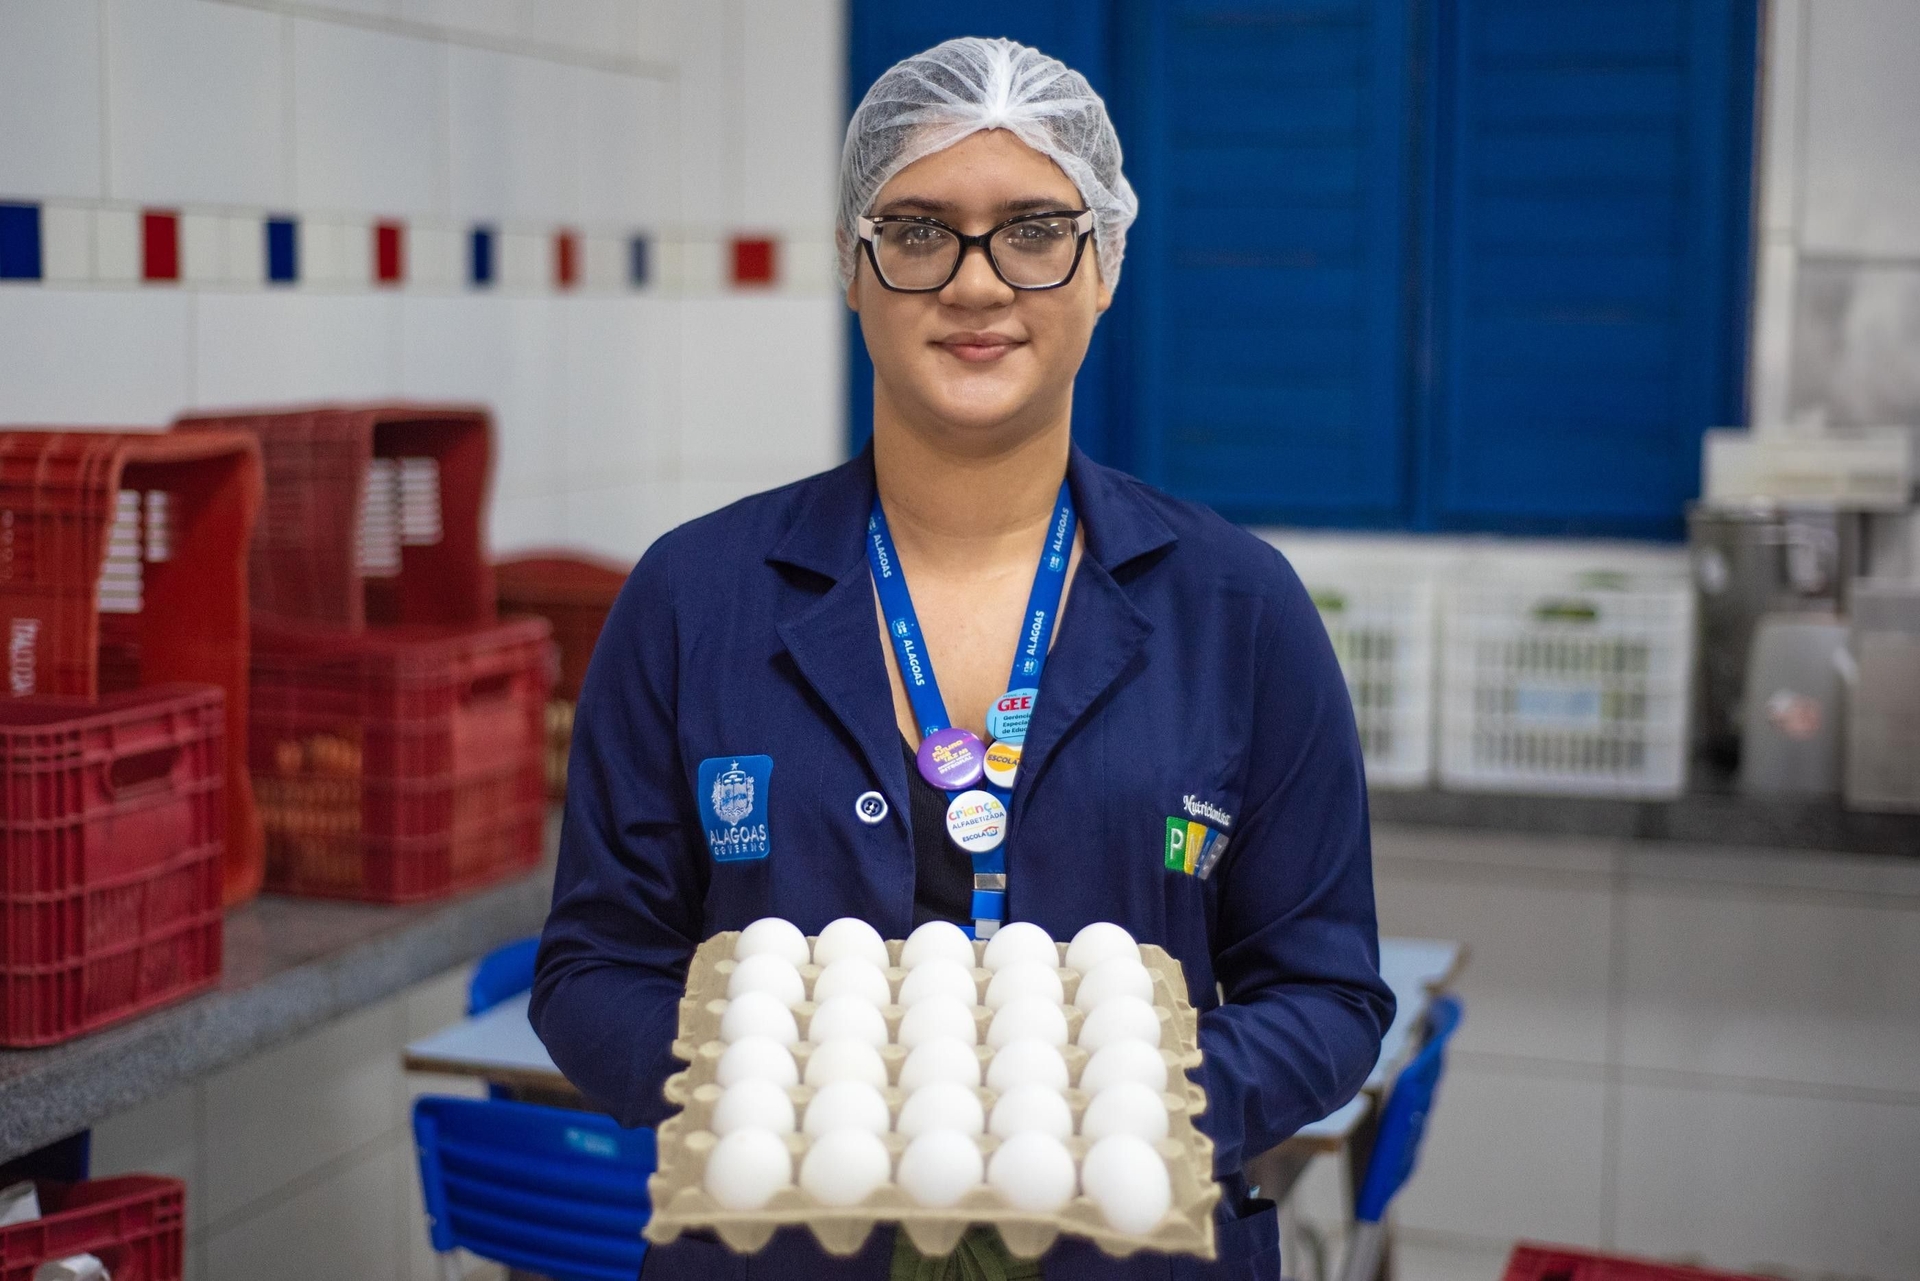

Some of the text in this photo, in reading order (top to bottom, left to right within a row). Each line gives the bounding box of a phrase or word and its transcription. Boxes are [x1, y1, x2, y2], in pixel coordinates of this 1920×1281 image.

[1052, 507, 1070, 552] ALAGOAS
[873, 534, 892, 578] ALAGOAS
[1026, 610, 1045, 656] ALAGOAS
[903, 639, 925, 686] ALAGOAS
[997, 696, 1032, 712] GEE
[948, 800, 1001, 821] criança
[952, 812, 1005, 830] ALFABETIZADA
[710, 824, 766, 846] ALAGOAS
